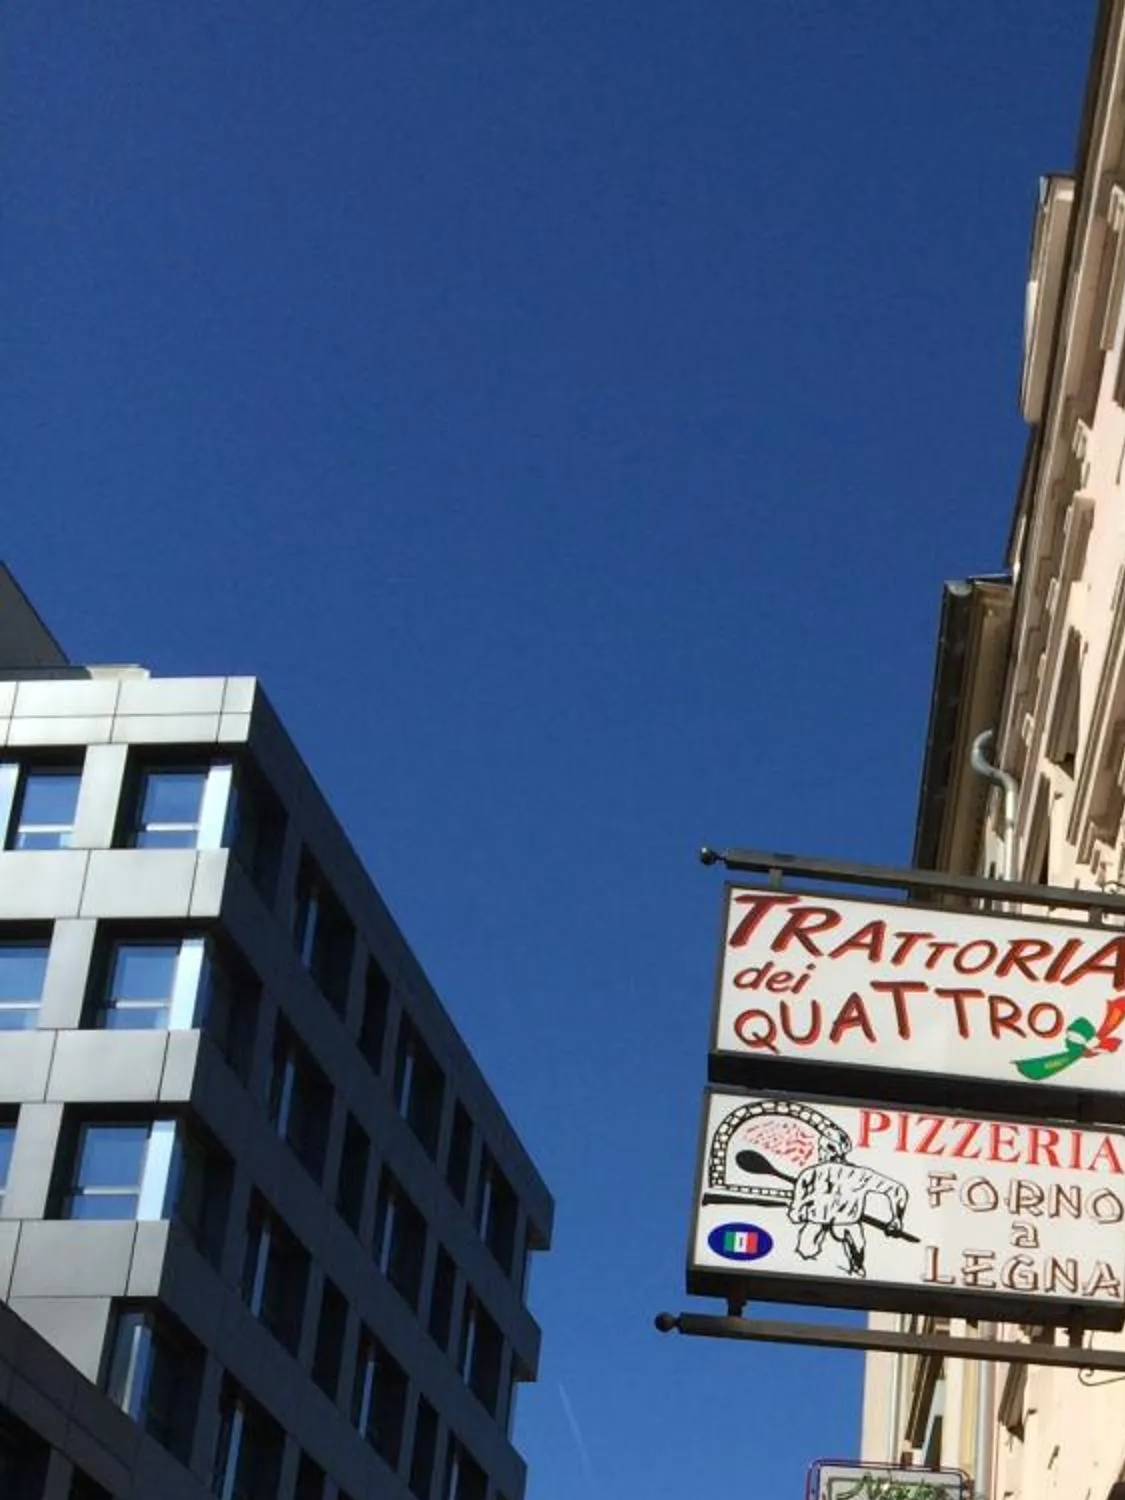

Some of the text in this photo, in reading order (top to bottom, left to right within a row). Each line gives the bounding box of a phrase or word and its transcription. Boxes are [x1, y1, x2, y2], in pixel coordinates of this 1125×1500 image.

[733, 961, 816, 993] dei
[733, 981, 1065, 1054] QUATTRO
[857, 1107, 1125, 1175] PIZZERIA
[926, 1171, 1124, 1224] FORNO
[1010, 1221, 1040, 1248] a
[923, 1246, 1122, 1298] LEGNA
